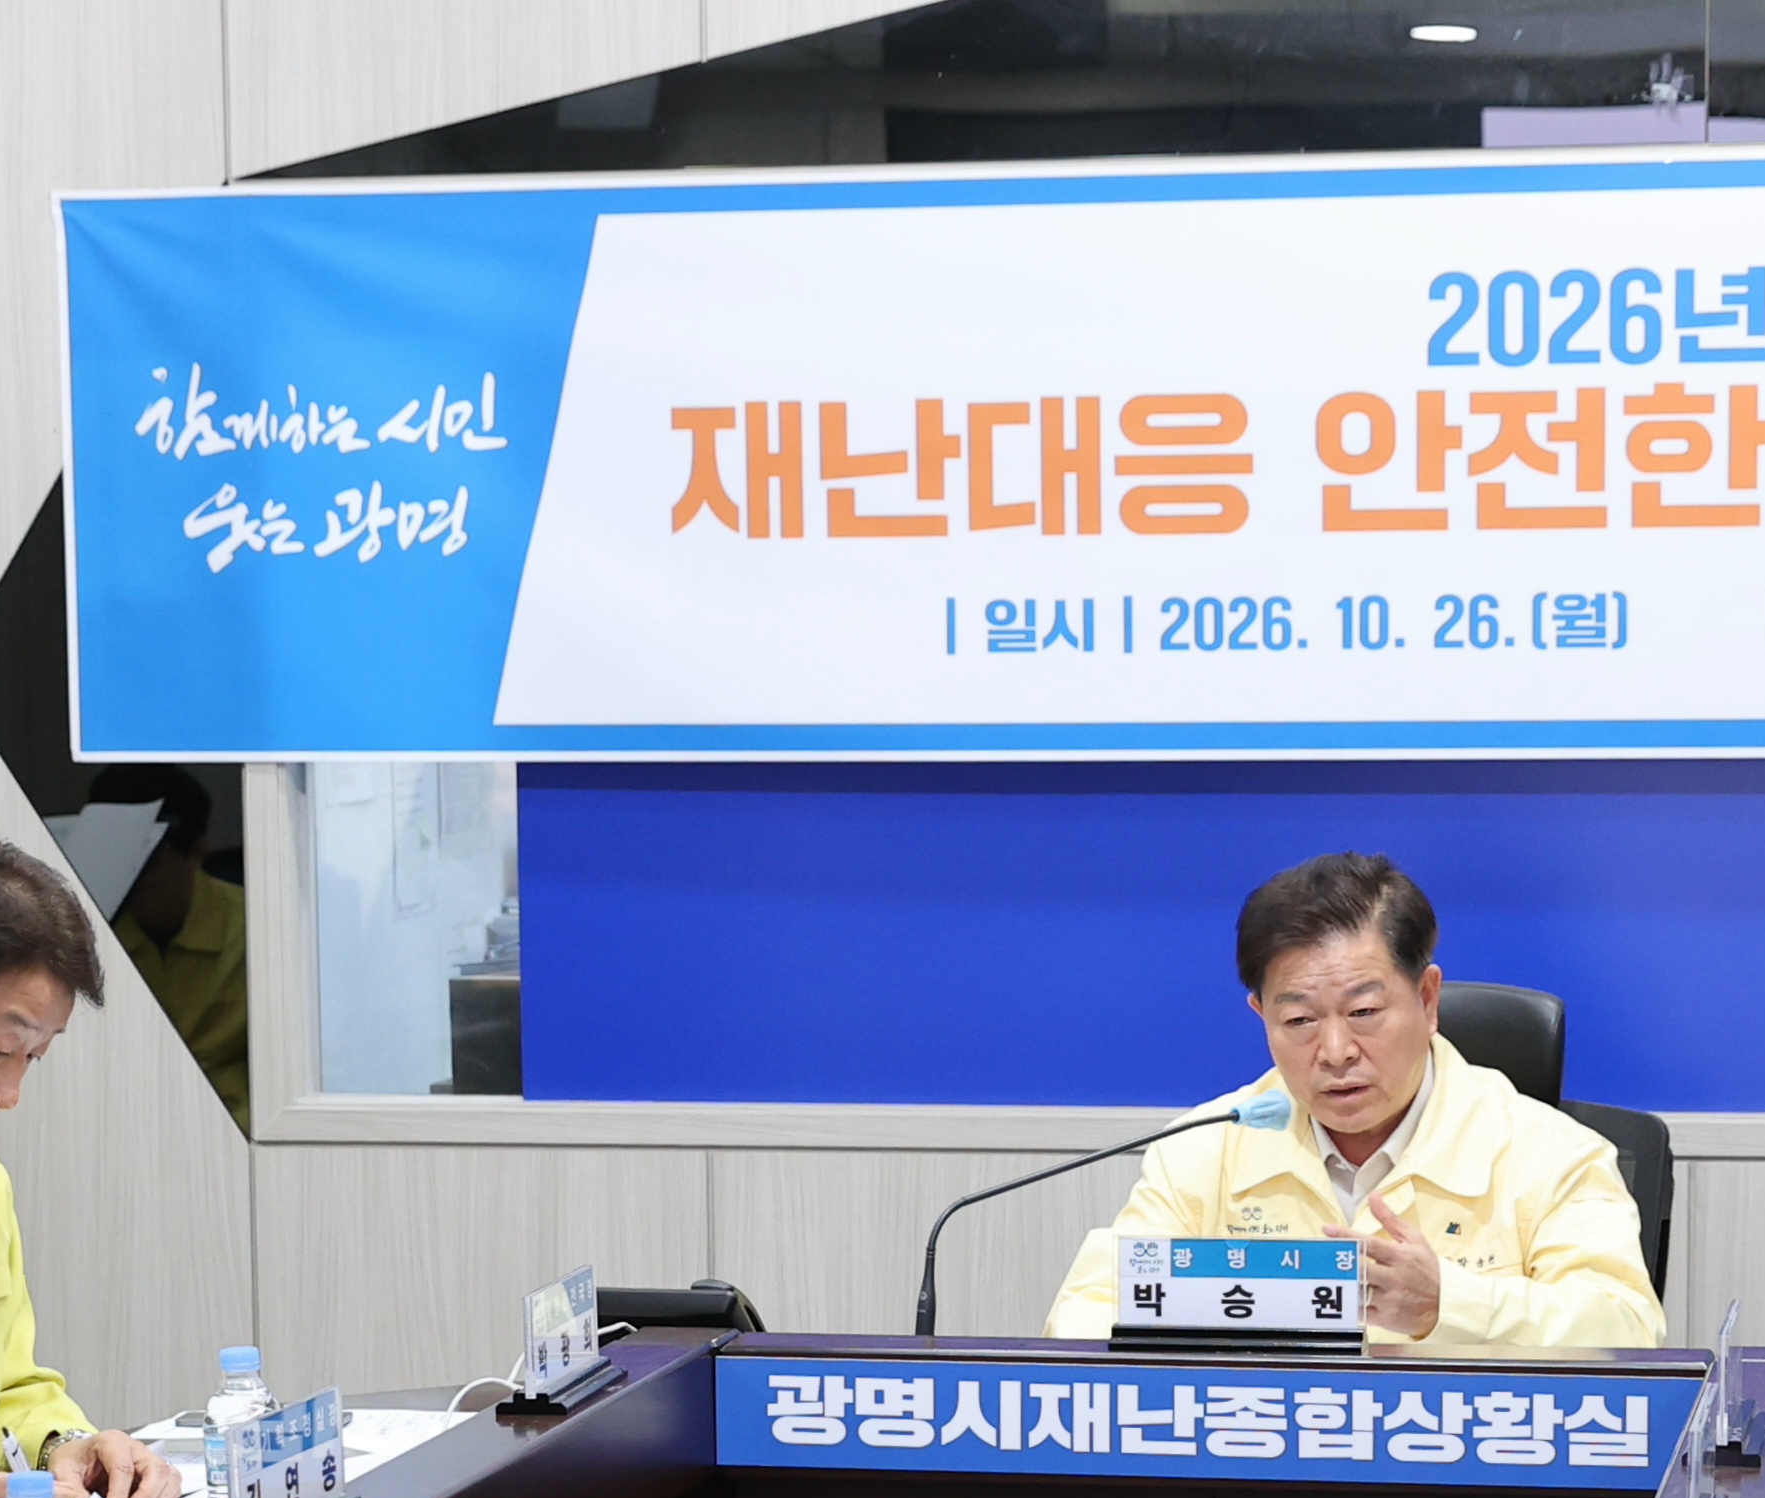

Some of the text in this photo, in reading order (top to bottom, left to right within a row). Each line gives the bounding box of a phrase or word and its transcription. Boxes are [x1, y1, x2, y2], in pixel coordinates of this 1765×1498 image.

[136, 363, 508, 460] 함께하는 시민
[671, 392, 1254, 540] 재난대응
[183, 480, 469, 574] 웃는 광명
[984, 598, 1095, 654] 일시
[1160, 597, 1309, 653] 2026.
[1335, 596, 1406, 651] 10.
[1134, 1282, 1344, 1320] 박승원
[1173, 1248, 1356, 1271] 광명시장
[766, 1373, 1650, 1467] 광명시재난종합상황실
